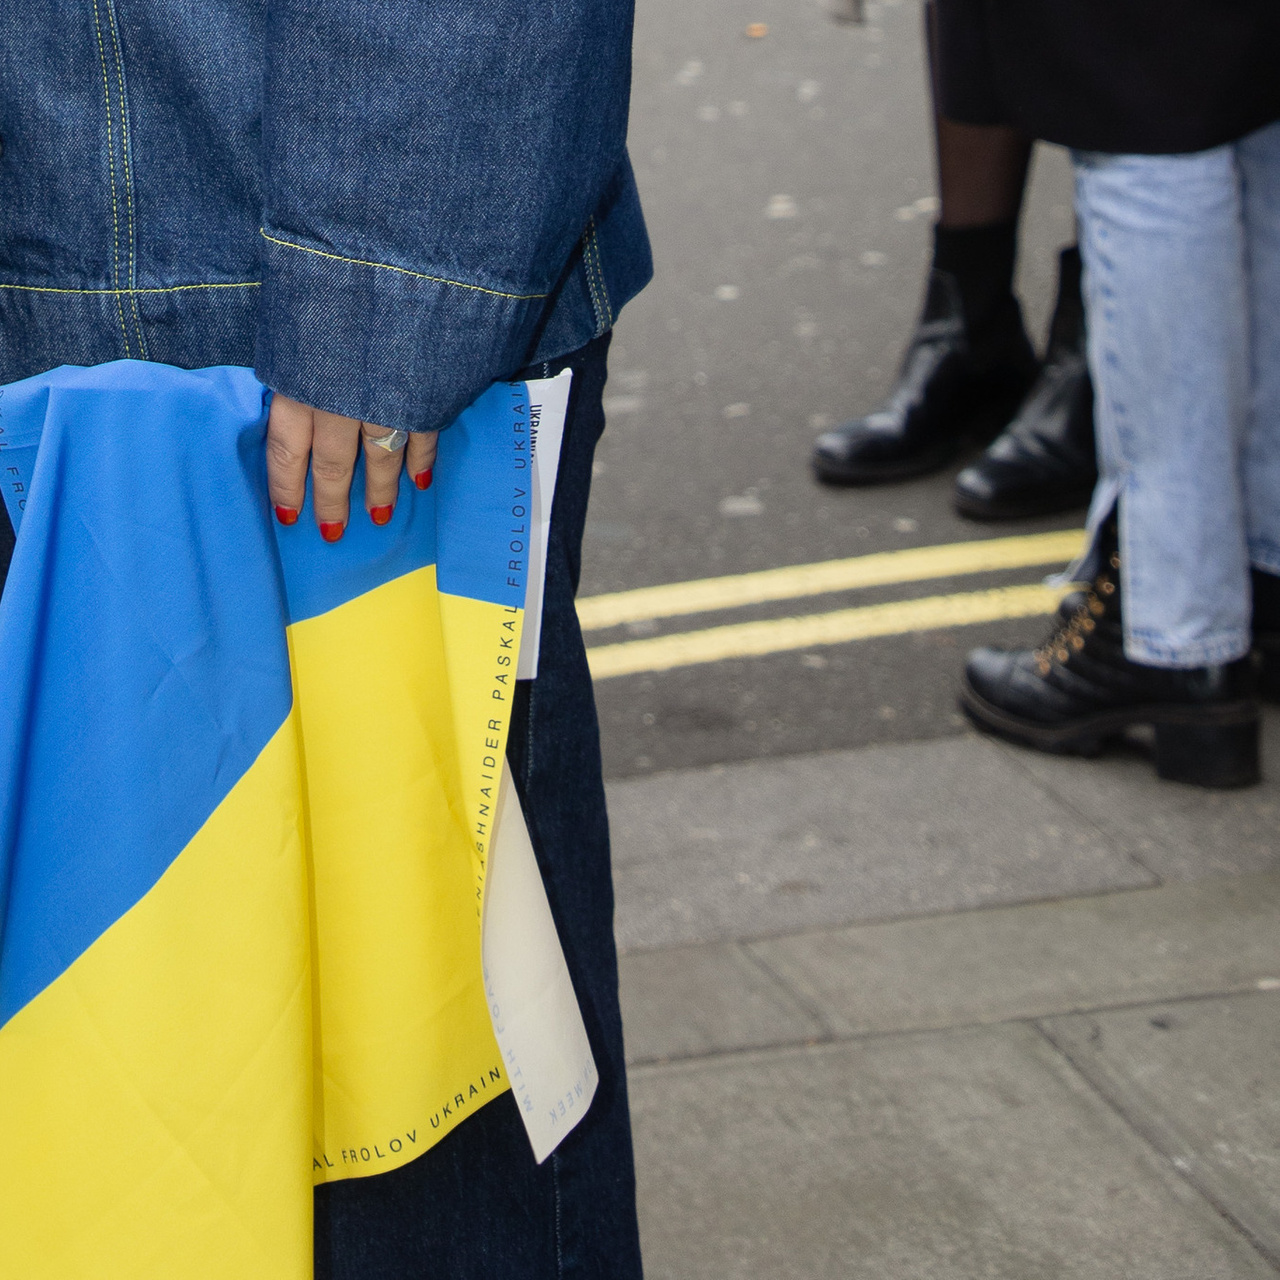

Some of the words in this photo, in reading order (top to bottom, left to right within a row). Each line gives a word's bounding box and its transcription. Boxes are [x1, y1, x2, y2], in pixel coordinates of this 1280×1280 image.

[492, 605, 519, 701] PASKAL
[507, 487, 526, 587] FROLOV
[313, 1154, 334, 1171] AL
[342, 1129, 417, 1164] FROLOV
[430, 1066, 501, 1128] UKRAIN
